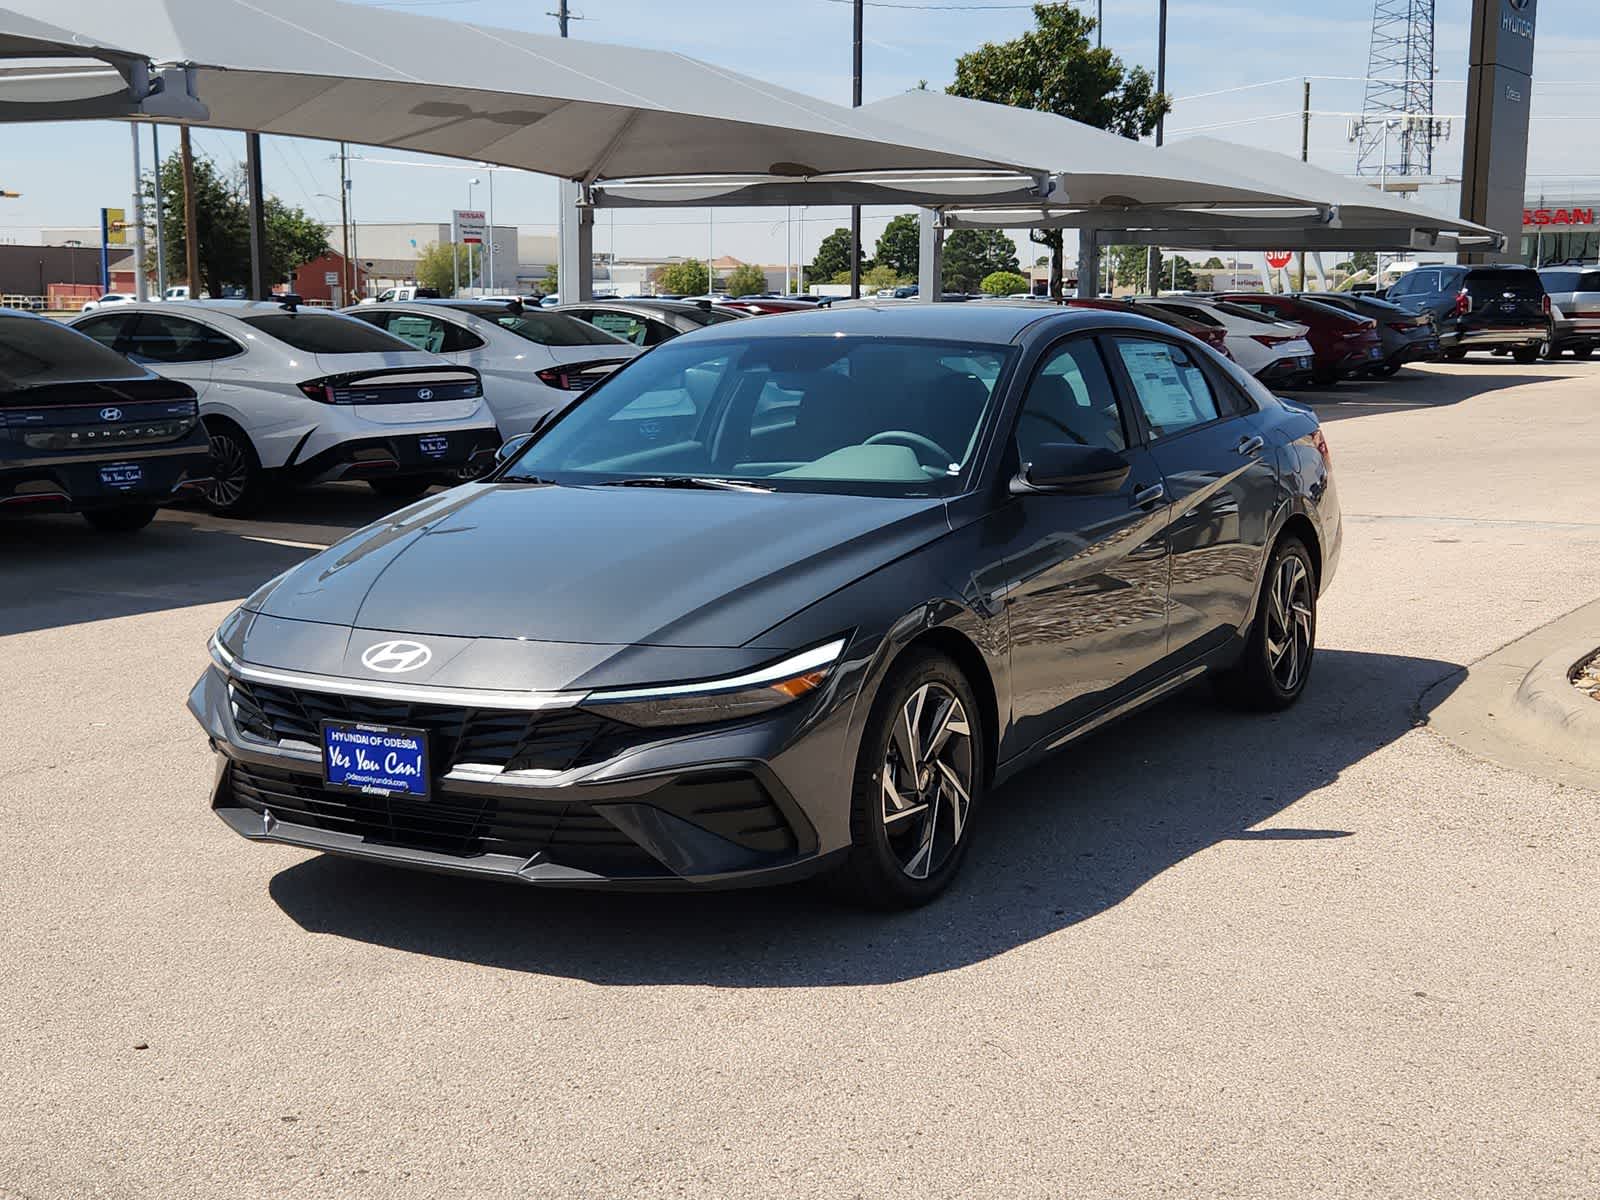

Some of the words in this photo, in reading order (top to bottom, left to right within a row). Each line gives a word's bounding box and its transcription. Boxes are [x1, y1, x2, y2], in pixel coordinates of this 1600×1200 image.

[1502, 15, 1533, 38] HYUNDAI
[1523, 207, 1593, 224] SSAN
[1267, 251, 1288, 259] STOP
[71, 428, 155, 439] SONATA
[331, 731, 369, 744] HYUNDAI
[370, 736, 383, 746] OF
[383, 738, 417, 749] ODESSA
[329, 745, 351, 768] Yes
[355, 748, 380, 770] You
[385, 752, 422, 777] Can!
[361, 784, 391, 798] driveway
